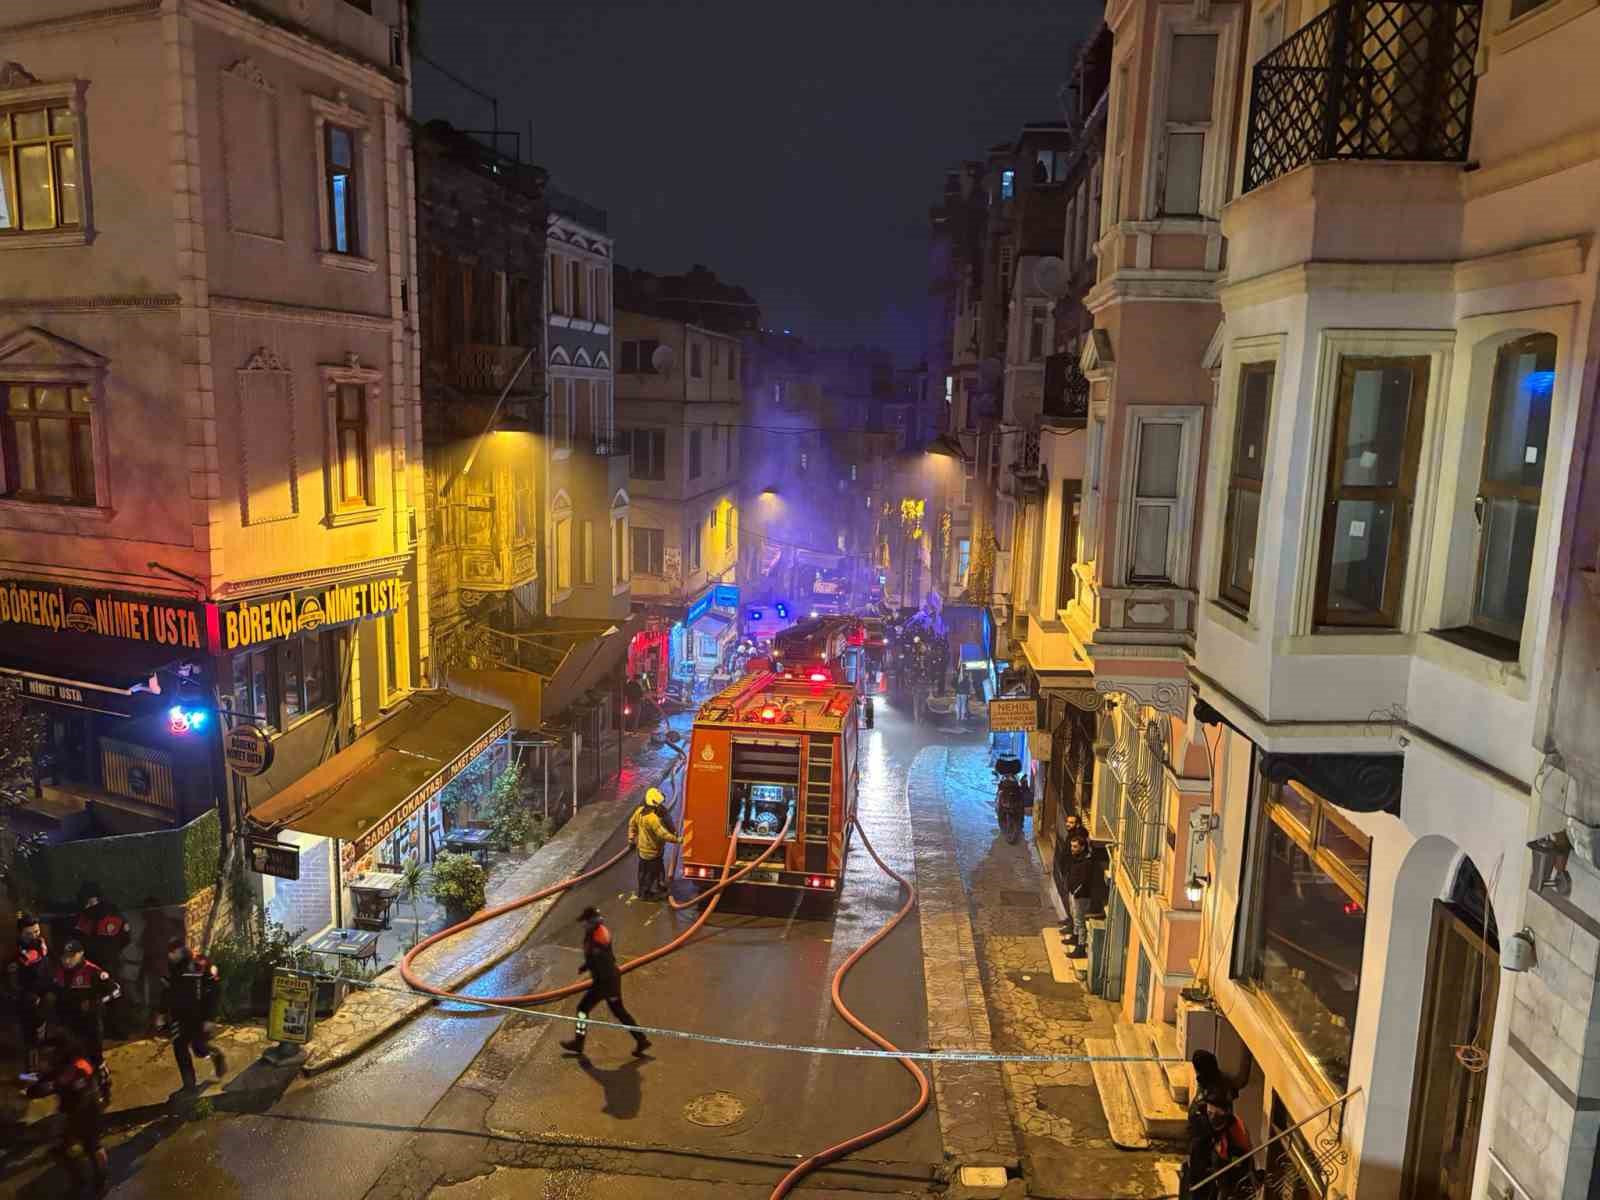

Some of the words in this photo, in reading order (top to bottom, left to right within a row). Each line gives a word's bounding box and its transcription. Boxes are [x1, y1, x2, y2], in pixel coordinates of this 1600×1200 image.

[0, 582, 66, 632] BÖREKÇİ
[95, 594, 149, 640] NİMET
[153, 606, 200, 648] USTA
[226, 592, 297, 649] BÖREKÇİ
[325, 584, 368, 624] NİMET
[370, 577, 401, 614] USTA
[364, 814, 395, 850] SARAY
[397, 775, 443, 822] LOKANTASI
